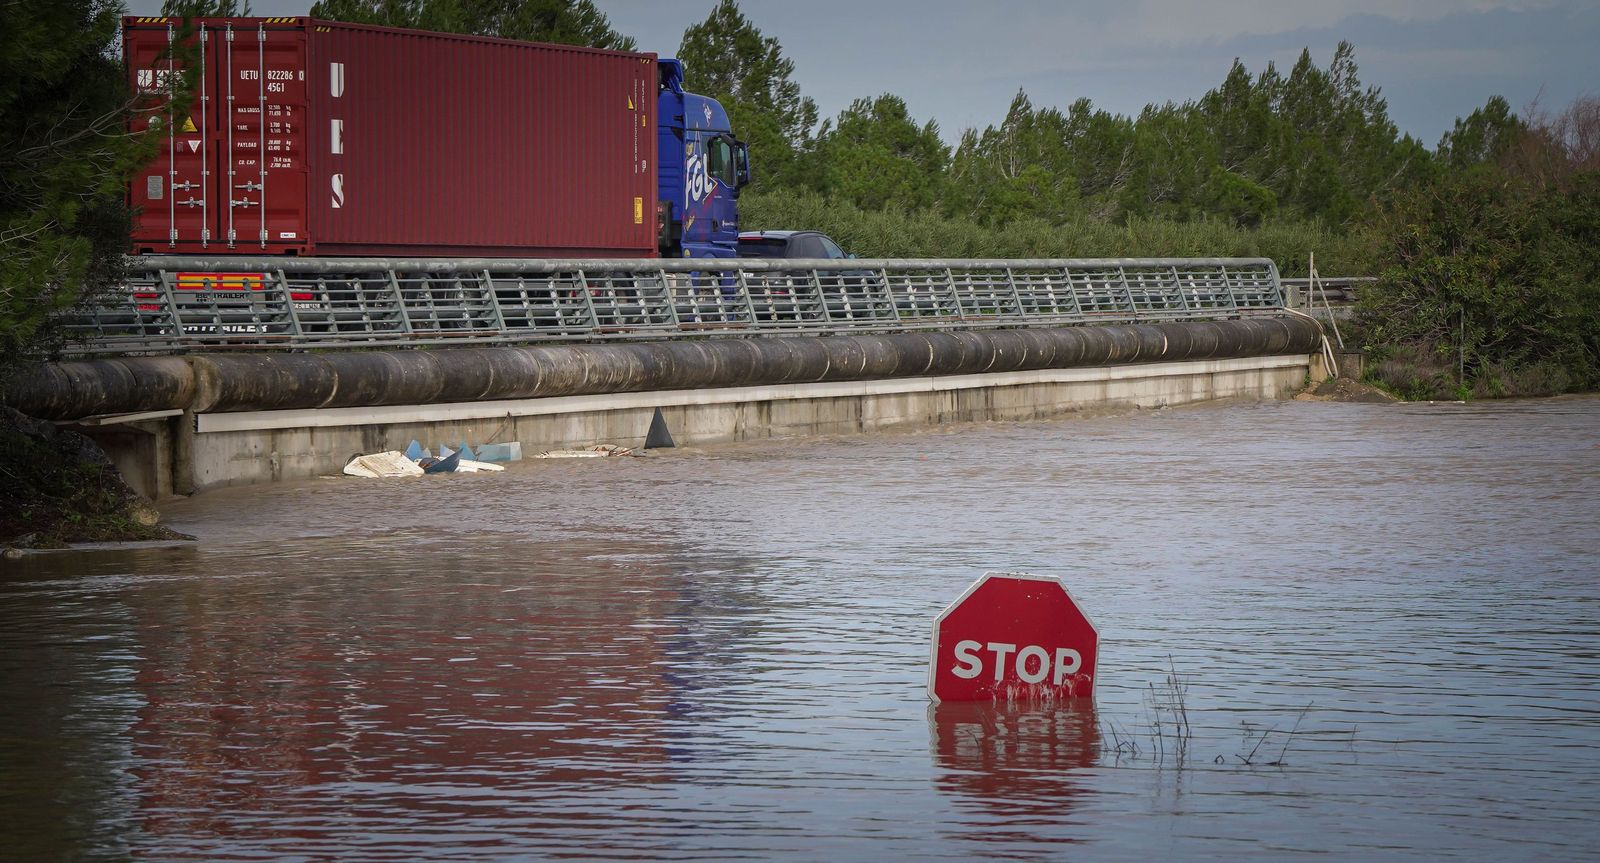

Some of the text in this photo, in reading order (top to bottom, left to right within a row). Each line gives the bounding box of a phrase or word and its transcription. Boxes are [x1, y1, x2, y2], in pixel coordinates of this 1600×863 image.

[240, 70, 305, 81] UETU 822286 0
[267, 82, 285, 92] 45G1
[951, 640, 1082, 686] STOP
